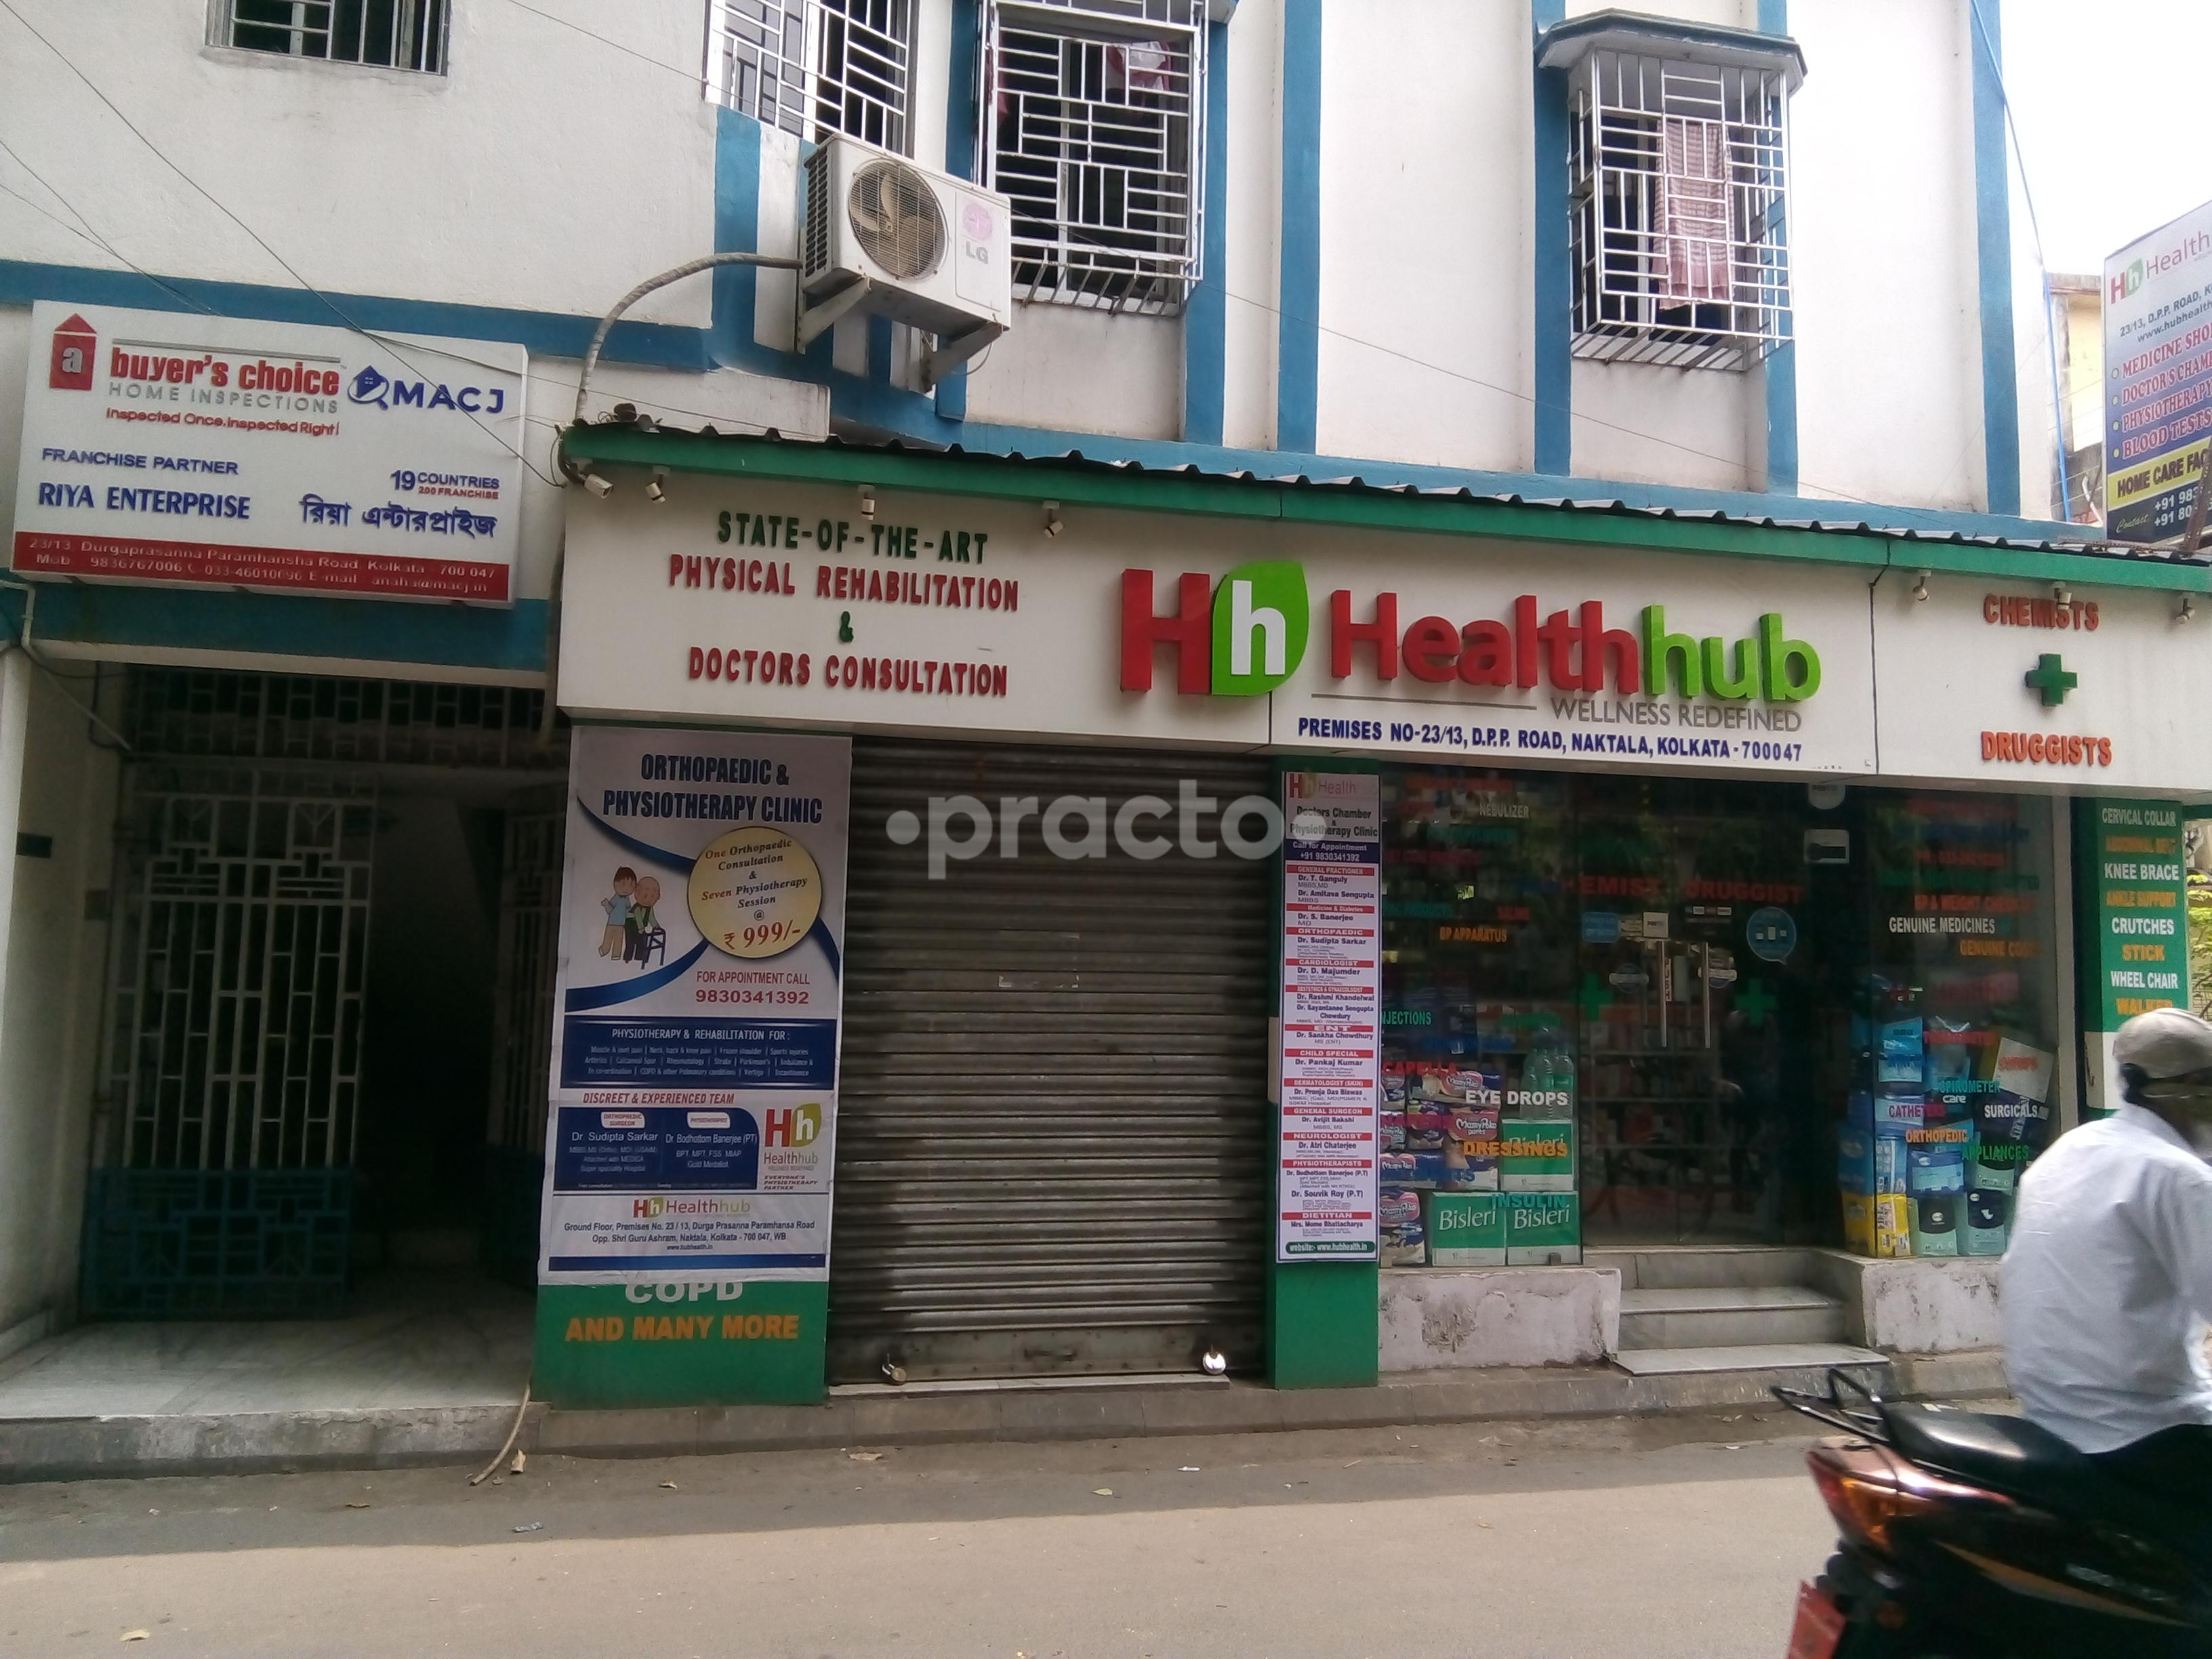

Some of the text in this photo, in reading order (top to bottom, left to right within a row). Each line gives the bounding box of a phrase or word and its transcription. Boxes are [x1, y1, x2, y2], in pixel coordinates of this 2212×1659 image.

[966, 241, 989, 264] LG
[2148, 305, 2171, 323] D.P.P.
[2173, 291, 2202, 311] ROAD,
[2123, 337, 2182, 379] MEDICINE
[110, 346, 339, 396] buyer's choice
[2123, 368, 2175, 405] DOCTOR'S
[108, 382, 337, 414] HOME INSPECTIONS
[393, 380, 505, 414] MACJ
[106, 407, 181, 424] Inspected
[2123, 408, 2212, 458] BLOOD TESTS
[42, 447, 239, 474] FRANCHISE PARTNER
[391, 470, 500, 491] 19 COUNTRIES
[2117, 457, 2184, 498] HOME CARE
[38, 483, 251, 520] RIYA ENTERPRISE
[438, 487, 499, 499] FRANCHISE
[81, 541, 203, 559] Durgaprasanna
[319, 556, 359, 570] Road
[440, 565, 466, 576] 700
[670, 553, 1019, 612] PHYSICAL REHABILITATION
[838, 610, 855, 643] &
[1330, 588, 1822, 703] Healthhub
[689, 646, 1008, 697] DOCTORS CONSULTATION
[1551, 697, 1802, 732] WELLNESS REDEFINED
[1298, 717, 1382, 741] PREMISES
[1472, 726, 1511, 747] D.P.P.
[1518, 729, 1567, 755] ROAD,
[1571, 733, 1654, 758] NAKTALA,
[1981, 731, 2112, 766] DRUGGISTS
[640, 754, 790, 786] ORTHOPAEDIC &
[603, 790, 823, 824] PHYSIOTHERAPY CLINIC
[1332, 807, 1372, 819] Chamber
[1479, 803, 1530, 819] NEBULIZER
[2102, 807, 2177, 827] CERVICAL COLLAR
[1353, 825, 1378, 837] Clinic
[705, 839, 792, 860] One Orthopaedic
[1292, 841, 1308, 849] Call
[1322, 843, 1367, 852] Appointment
[718, 854, 783, 871] Consultation
[1300, 852, 1360, 862] +91 9830341392
[2104, 863, 2180, 881] KNEE BRACE
[701, 877, 808, 901] Seven Physiotherapy
[737, 896, 776, 909] Session
[743, 919, 801, 949] 999/-
[1888, 916, 1996, 935] GENUINE MEDICINES
[2112, 918, 2175, 936] CRUTCHES
[697, 970, 810, 985] FOR APPOINTMENT CALL
[2110, 970, 2179, 989] WHEEL CHAIR
[695, 989, 809, 1005] 9830341392
[1382, 1010, 1432, 1026] NJECTIONS
[612, 1028, 682, 1039] PHYSIOTHERAPY
[683, 1029, 690, 1040] &
[695, 1029, 764, 1040] REHABILITATION
[1308, 1059, 1335, 1067] Pankaj
[583, 1092, 735, 1105] DISCREET & EXPERIENCED TEAM
[1465, 1090, 1569, 1106] EYE DROPS
[1984, 1104, 2038, 1118] SURGICALS
[571, 1132, 659, 1143] Dr Sudipta Sarkar
[1905, 1129, 1969, 1143] ORTHOPEDIC
[763, 1151, 819, 1165] Healthhub
[1463, 1141, 1568, 1157] DRESSINGS
[666, 1198, 751, 1214] Healthhub
[564, 1223, 592, 1231] Ground
[593, 1223, 614, 1232] Floor,
[616, 1223, 649, 1231] Premises
[692, 1222, 714, 1231] Durga
[716, 1221, 749, 1229] Prasanna
[751, 1221, 794, 1229] Paramhansa
[796, 1221, 815, 1229] Road
[1439, 1206, 1496, 1231] Bisleri
[1513, 1204, 1570, 1229] Bisleri
[592, 1234, 610, 1244] Opp.
[611, 1234, 627, 1243] Shri
[628, 1234, 647, 1243] Guru
[648, 1234, 678, 1244] Ashram,
[680, 1233, 709, 1243] Naktala,
[711, 1233, 737, 1241] Kolkata
[743, 1233, 756, 1241] 700
[774, 1232, 787, 1240] WB
[625, 1281, 744, 1305] COPD
[564, 1314, 800, 1343] AND MANY MORE
